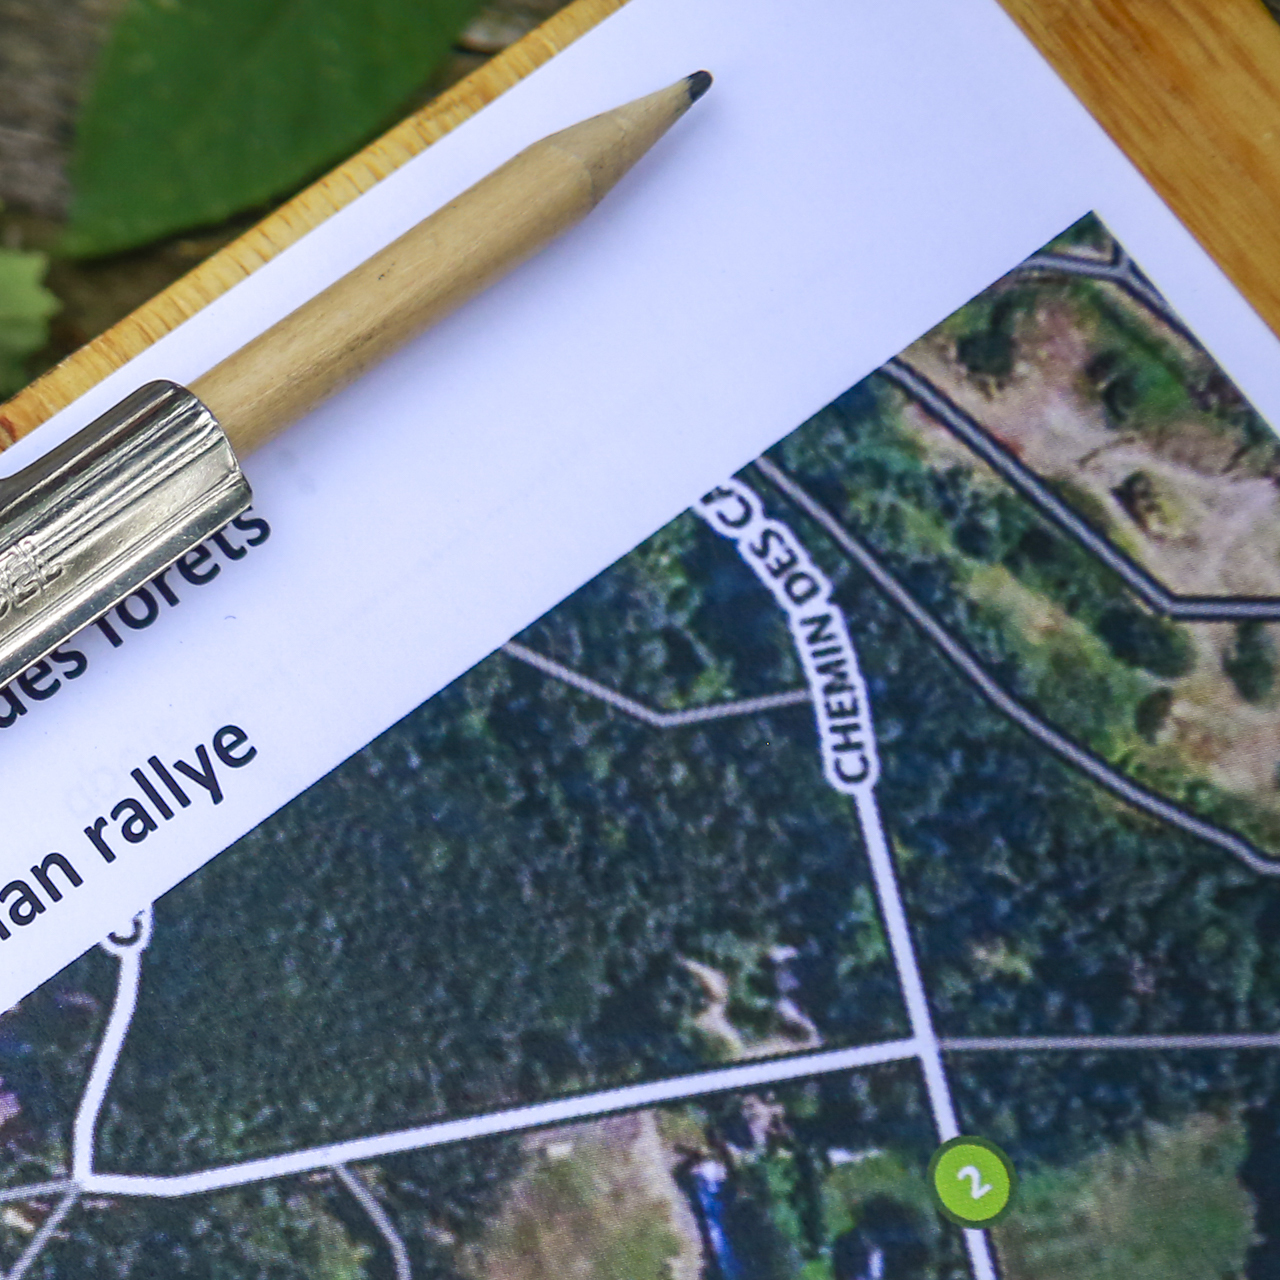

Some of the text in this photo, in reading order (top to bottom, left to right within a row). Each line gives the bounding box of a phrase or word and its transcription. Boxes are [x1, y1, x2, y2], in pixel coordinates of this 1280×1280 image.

[749, 528, 821, 605] DES
[800, 612, 870, 786] CHEMIN
[83, 724, 258, 864] rallye
[956, 1165, 993, 1200] 2
